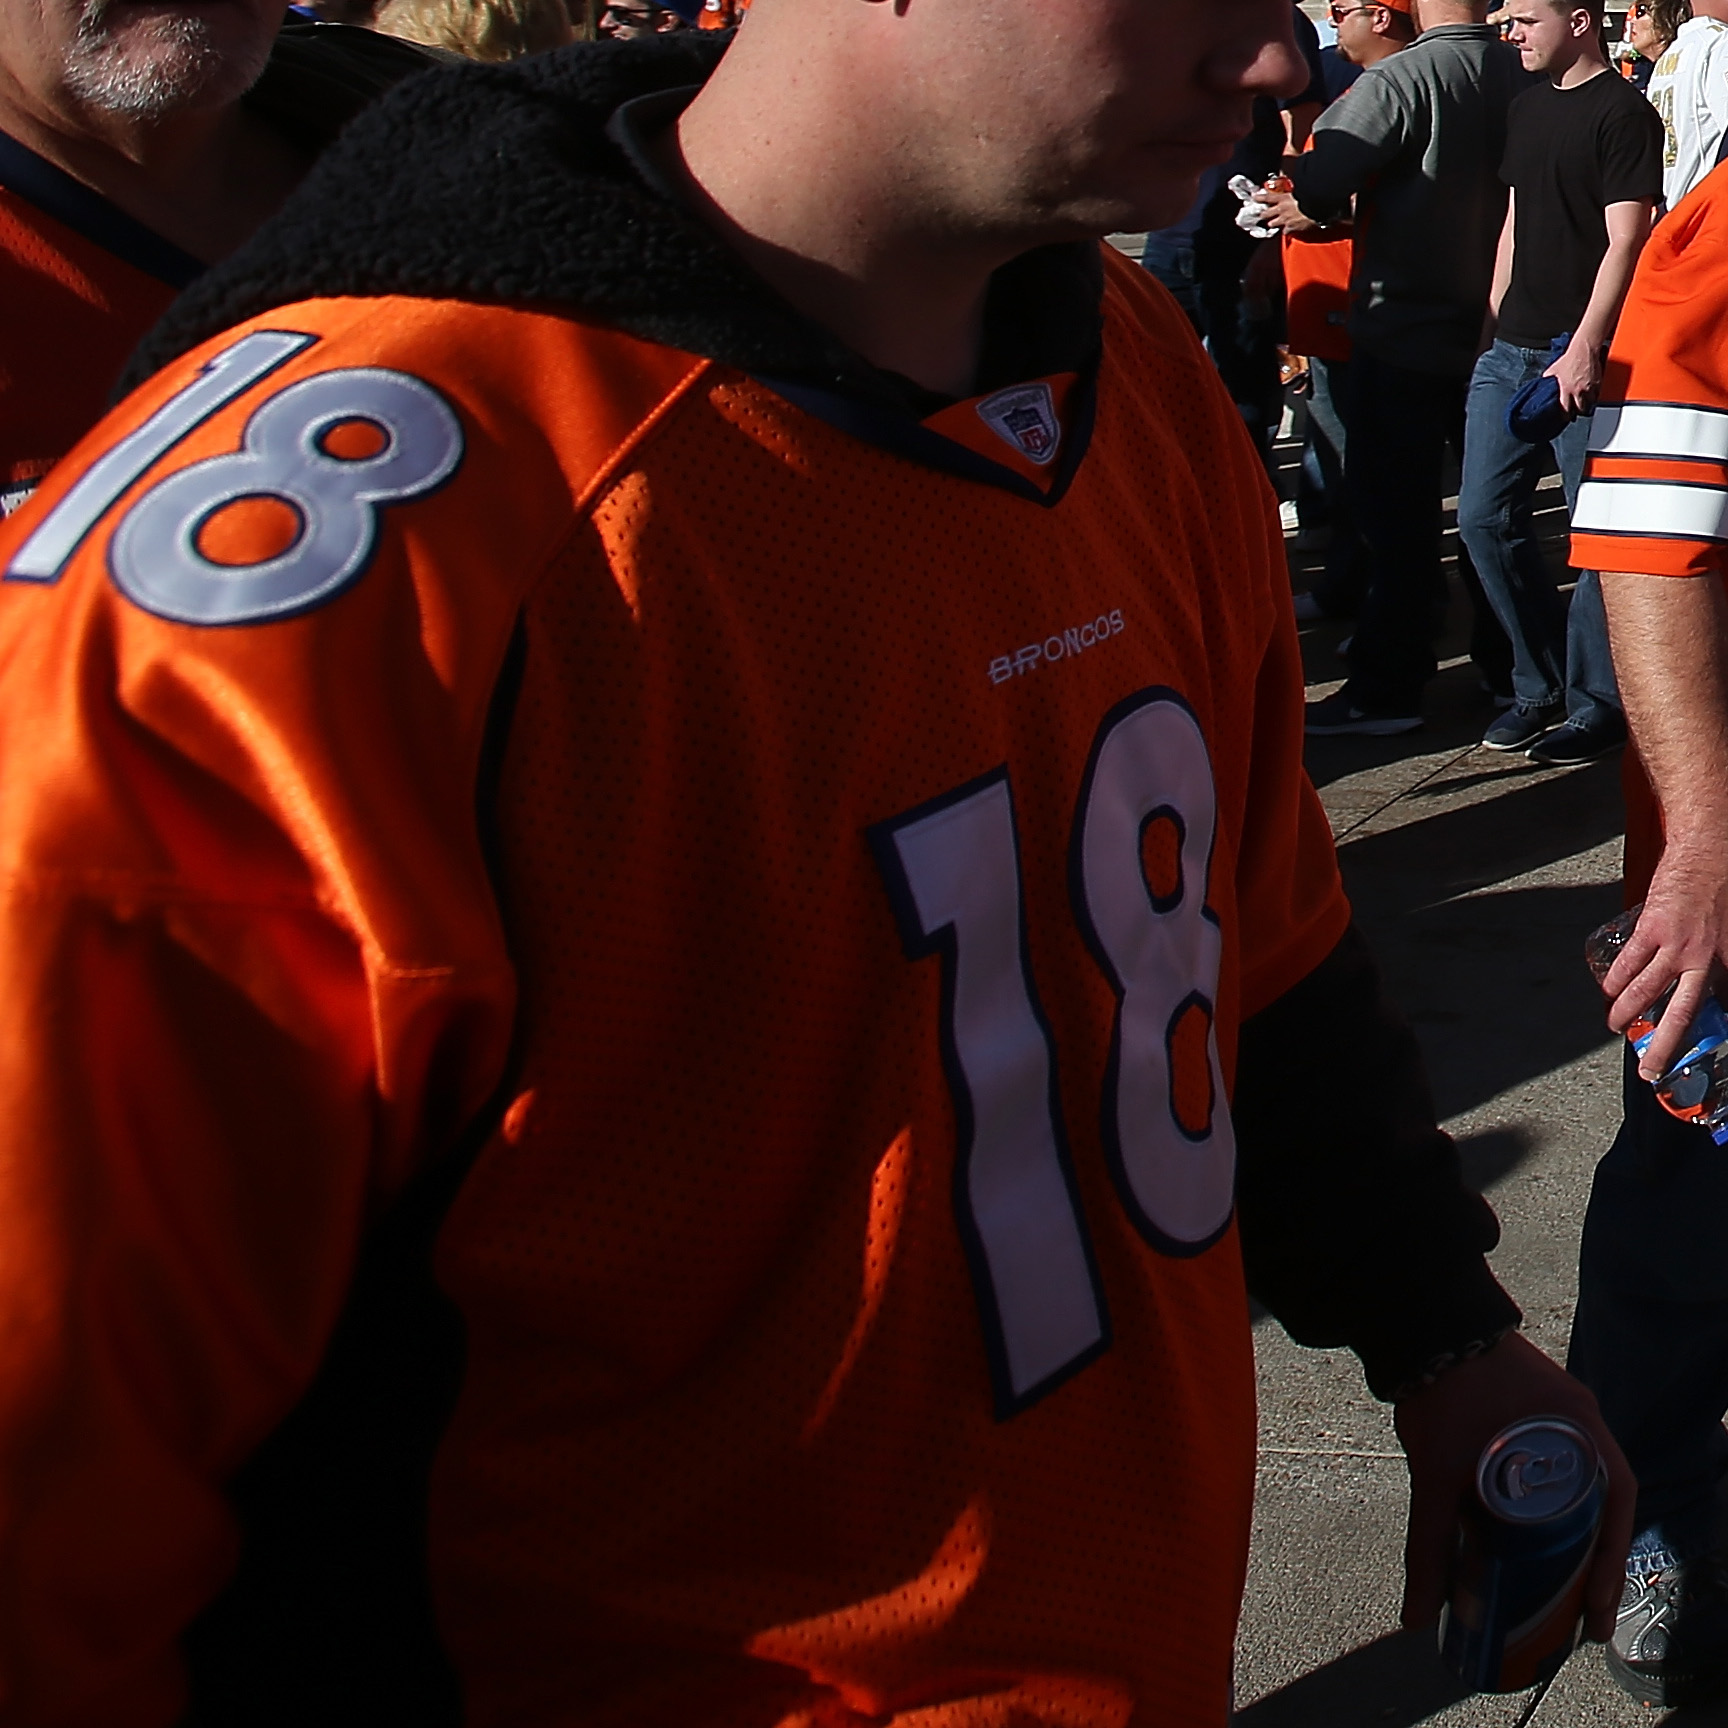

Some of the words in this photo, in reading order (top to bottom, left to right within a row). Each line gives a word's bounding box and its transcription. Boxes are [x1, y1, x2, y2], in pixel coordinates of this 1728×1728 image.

[2, 327, 467, 630] 18
[987, 608, 1126, 686] BRONCOS
[867, 683, 1238, 1422] 18
